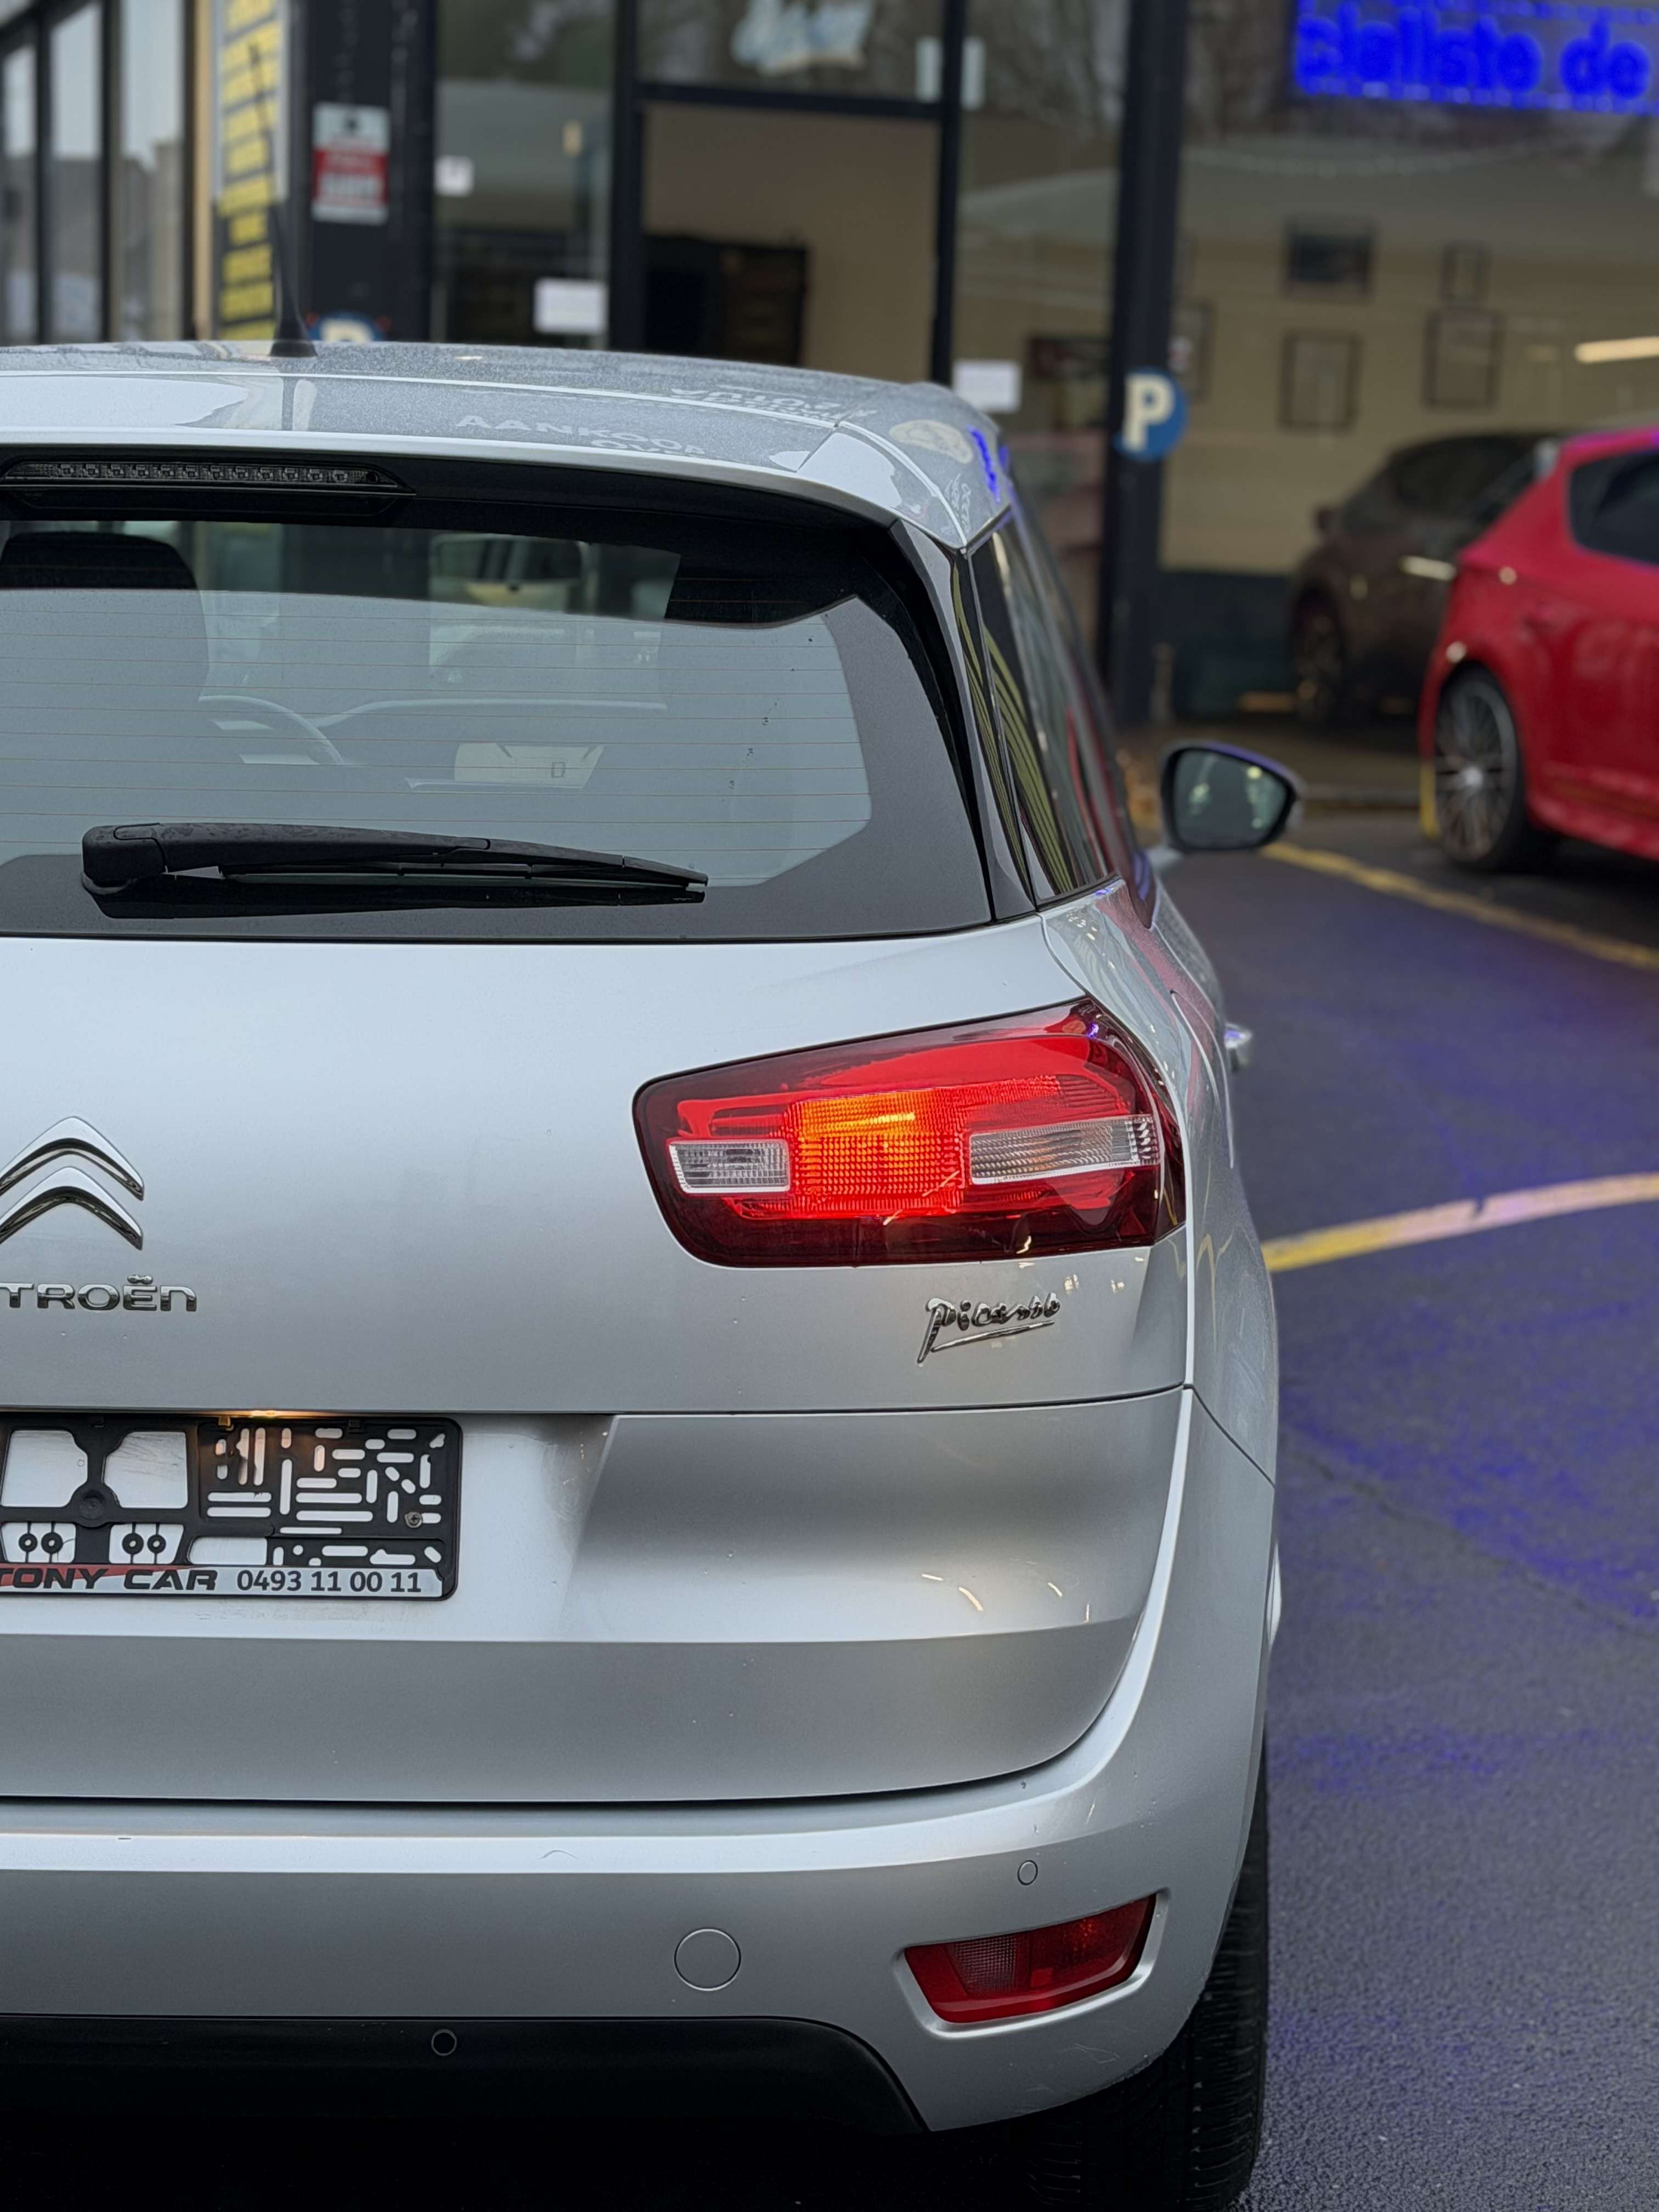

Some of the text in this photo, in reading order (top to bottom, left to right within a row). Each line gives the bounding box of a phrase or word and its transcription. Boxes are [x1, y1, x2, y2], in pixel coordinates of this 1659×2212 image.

[1123, 373, 1176, 452] P
[123, 1569, 218, 1590] CAR
[236, 1570, 302, 1592] 0493
[311, 1571, 342, 1592] 11
[349, 1571, 383, 1592] 00
[391, 1571, 422, 1593] 11
